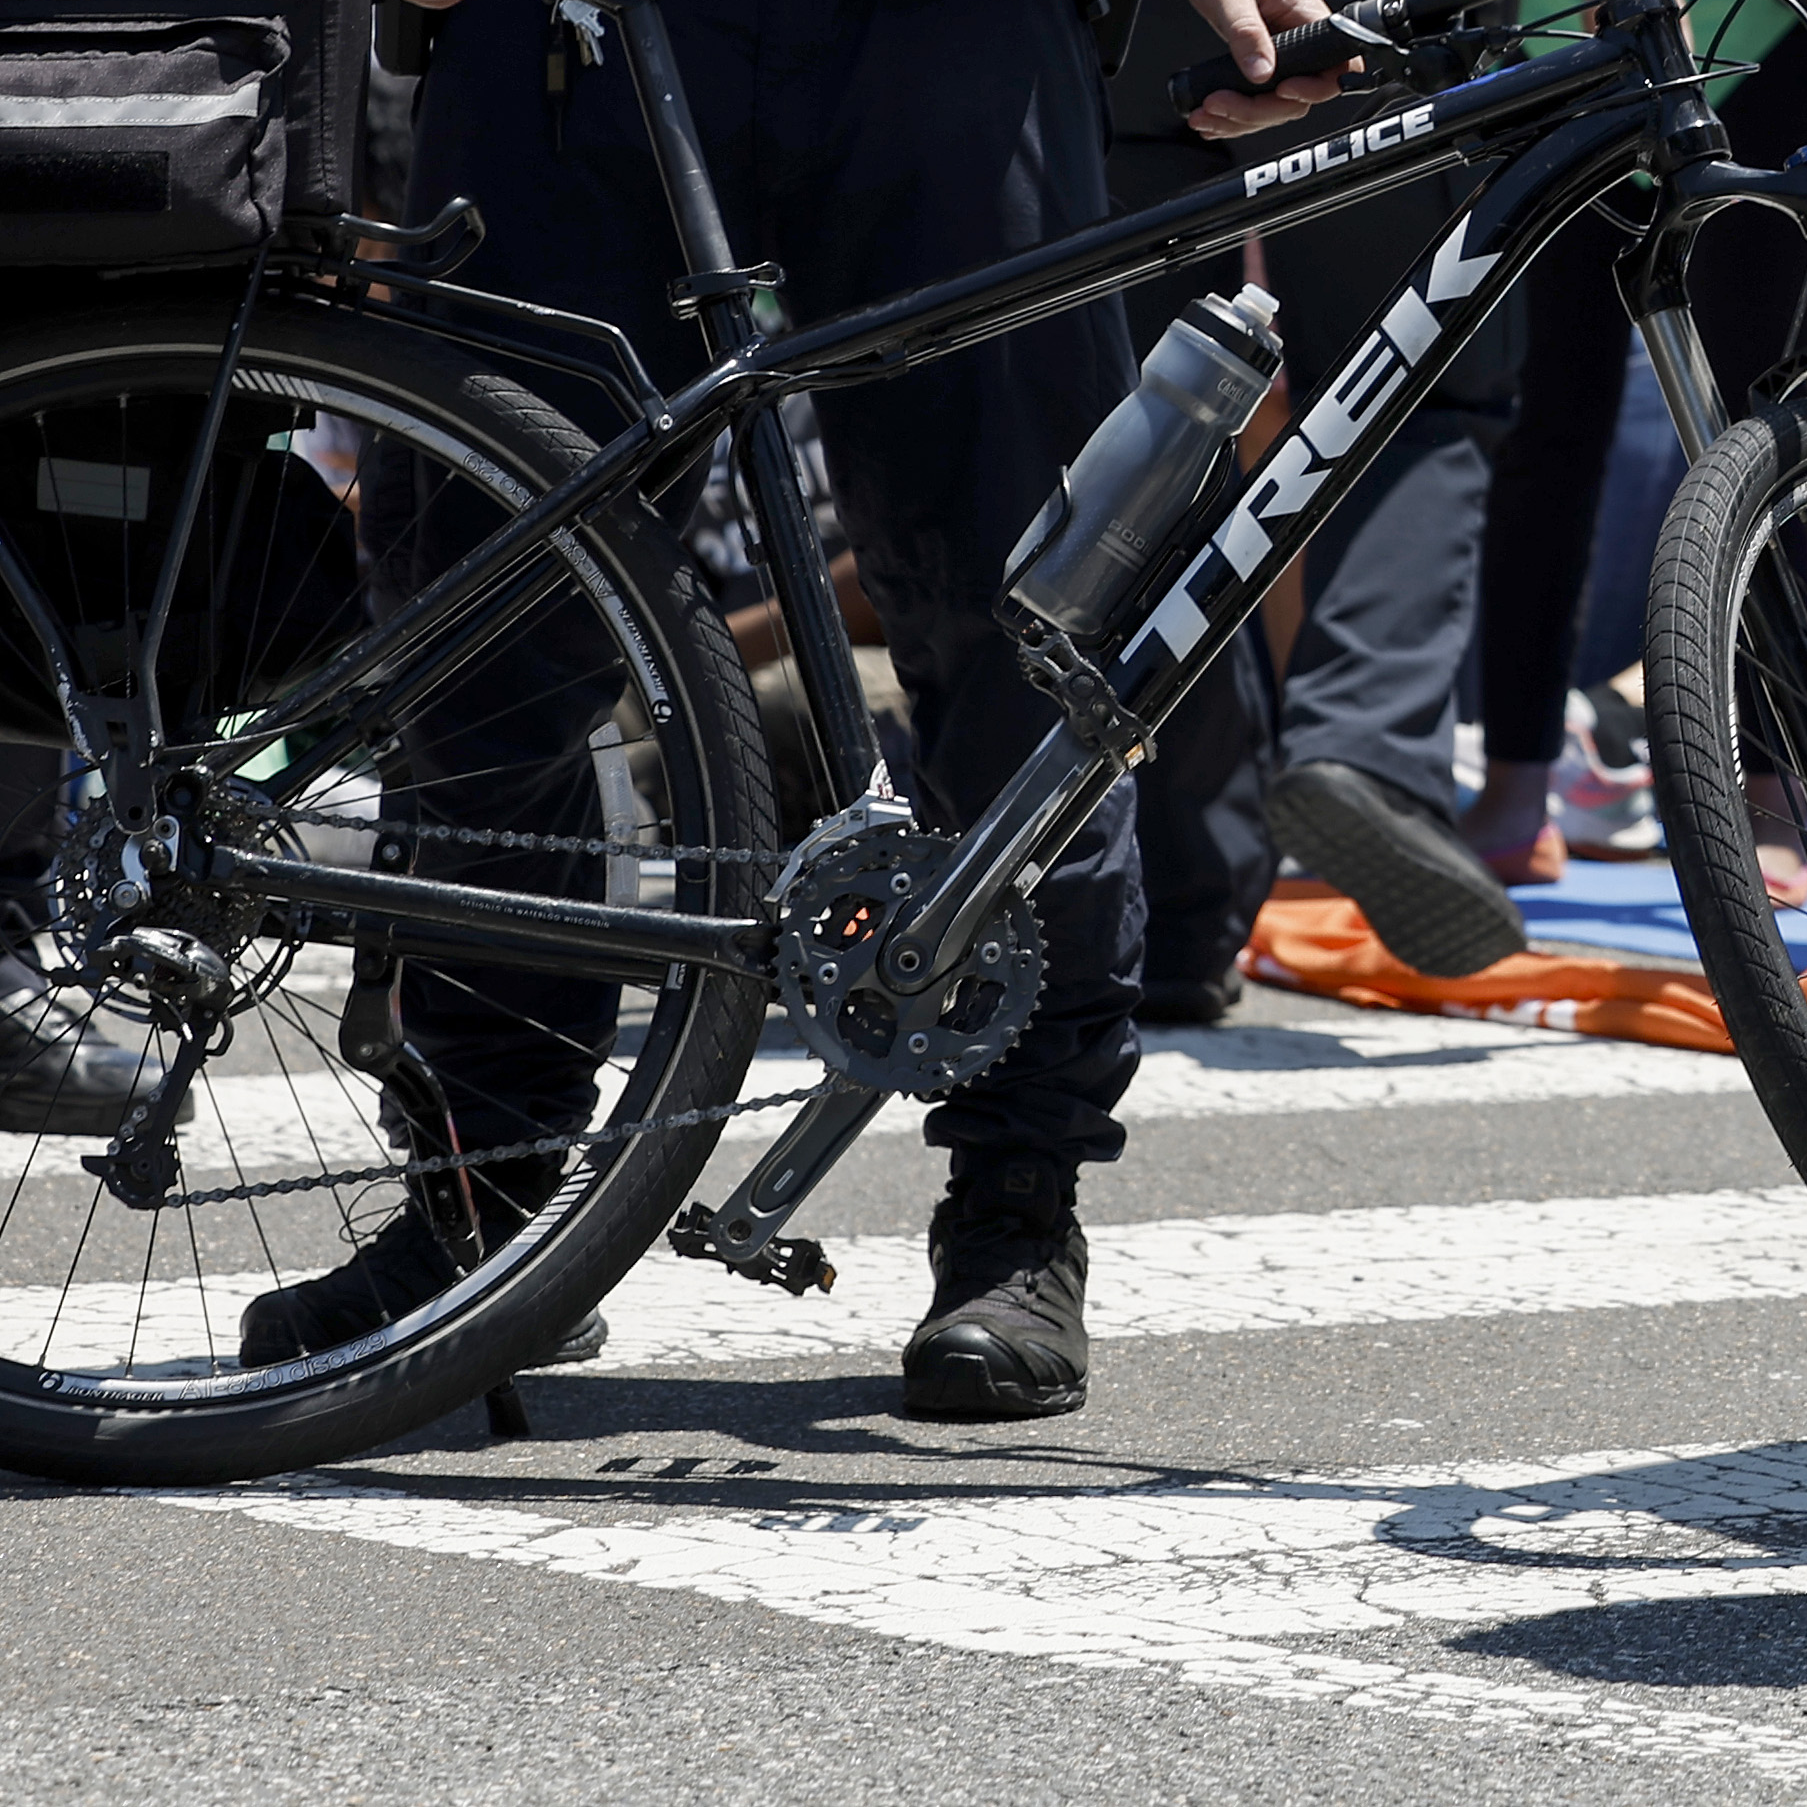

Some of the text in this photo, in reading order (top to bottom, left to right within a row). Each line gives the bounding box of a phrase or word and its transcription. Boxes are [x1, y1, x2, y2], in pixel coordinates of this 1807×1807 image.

[1244, 103, 1435, 198] POLICE
[1118, 209, 1504, 664] TREK
[515, 908, 561, 922] WATERLOO
[563, 914, 610, 929] WISCONSIN
[177, 1367, 284, 1401] AT-850
[288, 1351, 346, 1383] disc
[350, 1330, 388, 1359] 29
